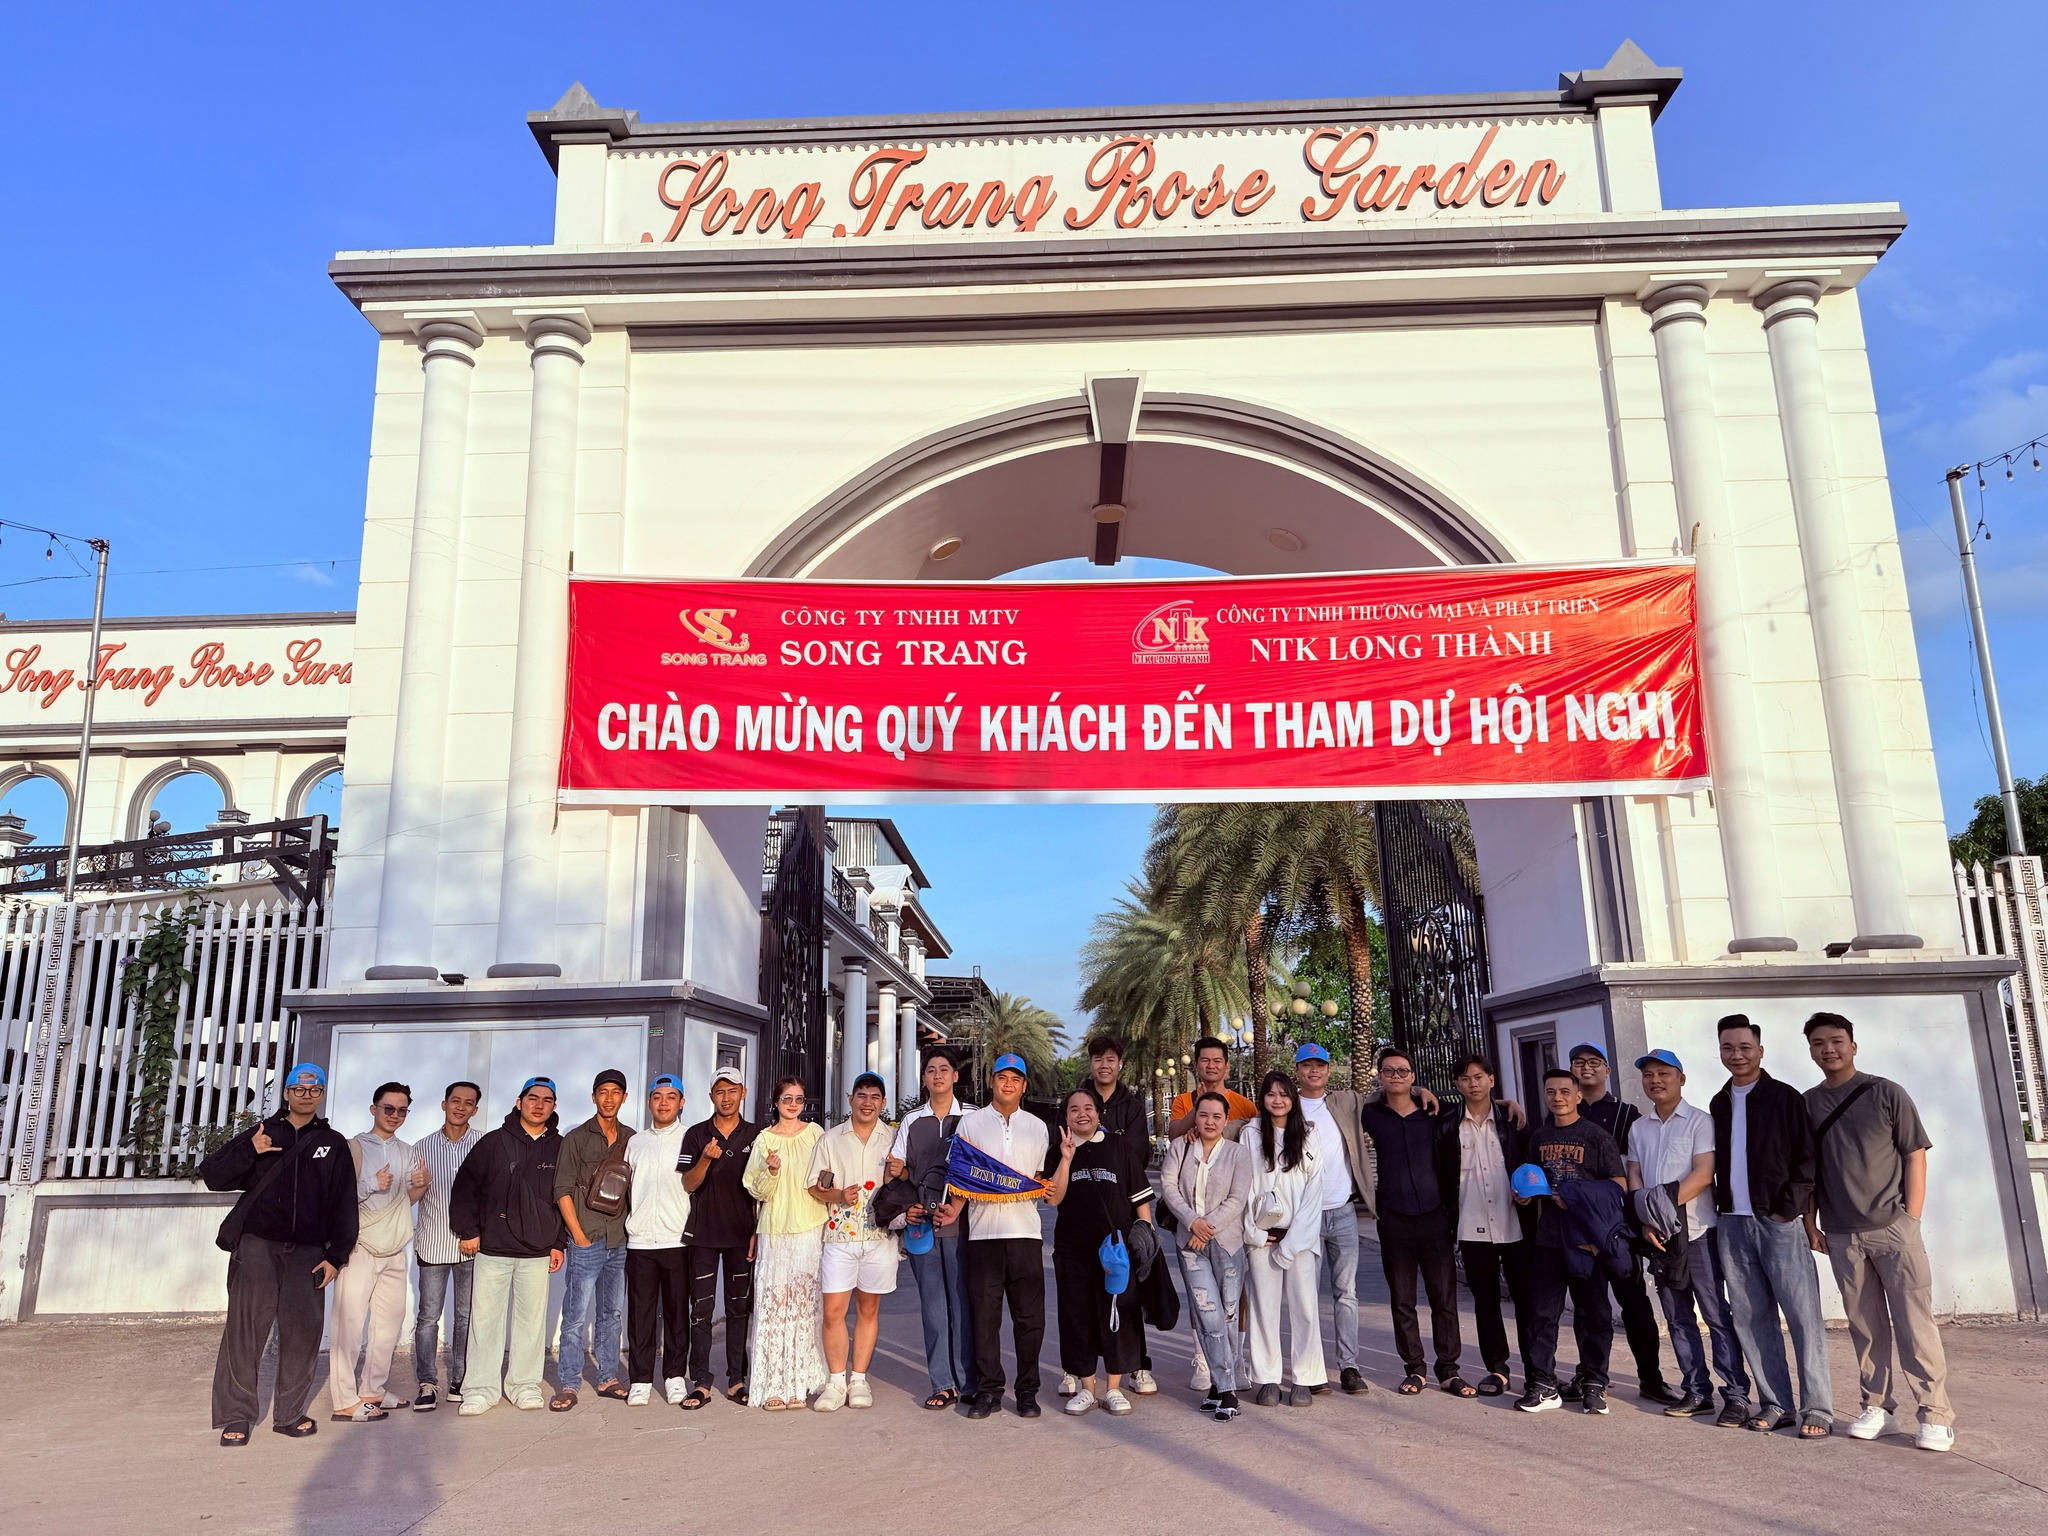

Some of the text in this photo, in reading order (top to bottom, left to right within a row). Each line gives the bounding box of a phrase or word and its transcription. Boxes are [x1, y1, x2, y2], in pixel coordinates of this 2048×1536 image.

[833, 145, 1058, 238] Trang
[1064, 136, 1275, 229] Rose
[1301, 125, 1566, 222] Garden
[781, 606, 1020, 626] CÔNG TY TNHH MTV
[1216, 604, 1265, 624] CÔNG
[1268, 607, 1292, 623] TY
[1294, 606, 1343, 622] TNHH
[1347, 603, 1423, 621] THƯƠNG
[1427, 603, 1461, 622] MẠI
[1466, 598, 1491, 618] VÀ
[1495, 596, 1542, 617] PHÁT
[1152, 608, 1210, 644] NTK
[780, 640, 1028, 666] SONG TRANG
[1249, 625, 1553, 662] NTK LONG THÀNH
[180, 642, 275, 688] Rose
[661, 652, 767, 667] SONG TRANG
[1153, 654, 1177, 664] LONG
[597, 683, 1677, 761] CHÀO MỪNG QUÝ KHÁCH ĐẾN THAM DỰ HỘI NGHỊ
[1539, 1144, 1584, 1164] TOKYO
[969, 1165, 1022, 1190] VIETSUN TOURIST
